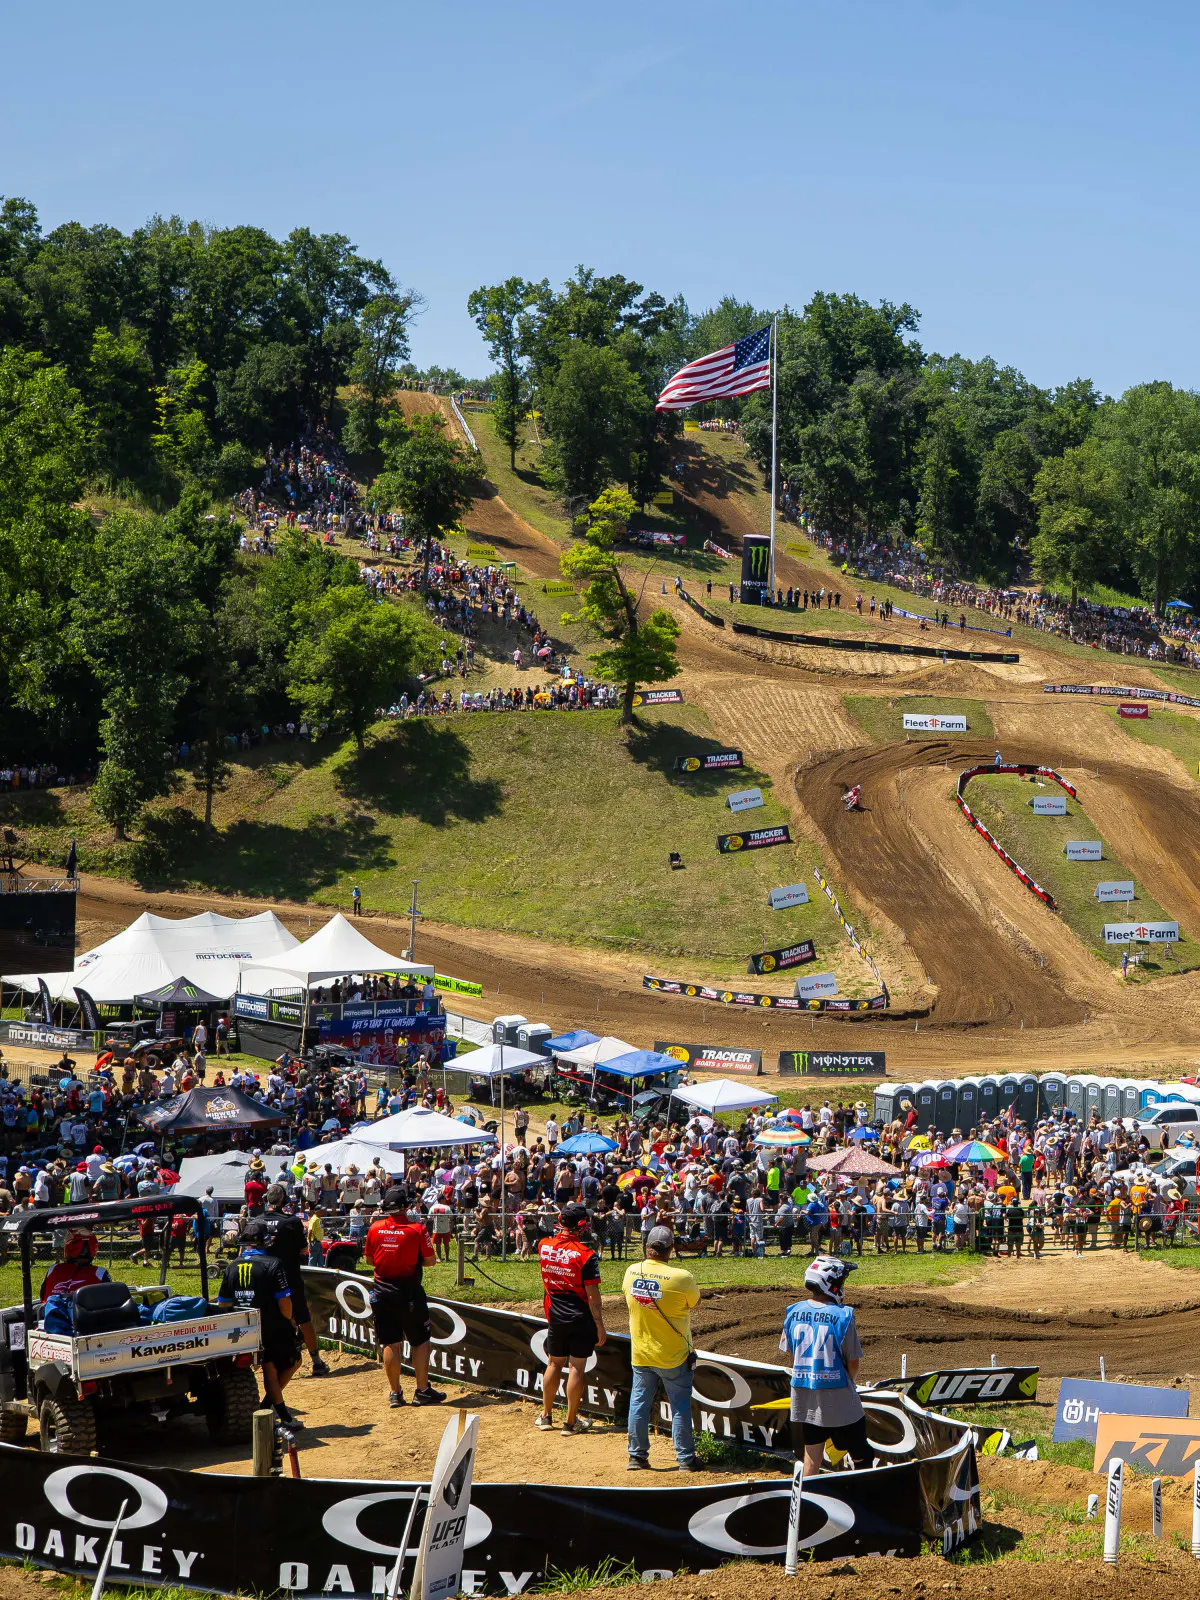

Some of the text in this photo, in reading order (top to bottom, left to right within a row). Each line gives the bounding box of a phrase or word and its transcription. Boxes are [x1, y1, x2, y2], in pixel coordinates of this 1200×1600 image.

[905, 719, 964, 729] Fleet Farm
[750, 829, 783, 840] TRACKER
[1107, 929, 1176, 940] Fleet Farm
[781, 944, 809, 958] TRACKER
[801, 984, 814, 992] Fleet
[377, 1007, 402, 1017] peacock
[352, 1019, 368, 1030] LET'S
[9, 1029, 77, 1045] MOTOCROSS
[701, 1050, 752, 1063] TRACKER
[813, 1055, 874, 1066] MONSTER
[695, 1060, 715, 1068] BOATS
[735, 1062, 752, 1070] ROAD
[206, 1109, 240, 1119] MIDWEST
[131, 1205, 153, 1214] MEDIC
[48, 1212, 100, 1224] alpinestars
[792, 1312, 839, 1325] FLAG CREW
[173, 1326, 196, 1337] MEDIC
[198, 1323, 218, 1334] MULE
[131, 1334, 209, 1359] Kawasaki
[793, 1324, 836, 1369] 24
[930, 1374, 1014, 1400] UFO
[1108, 1480, 1118, 1516] UFO
[432, 1515, 466, 1543] UFO
[429, 1534, 462, 1552] PLAST
[16, 1522, 200, 1579] OAKLEY
